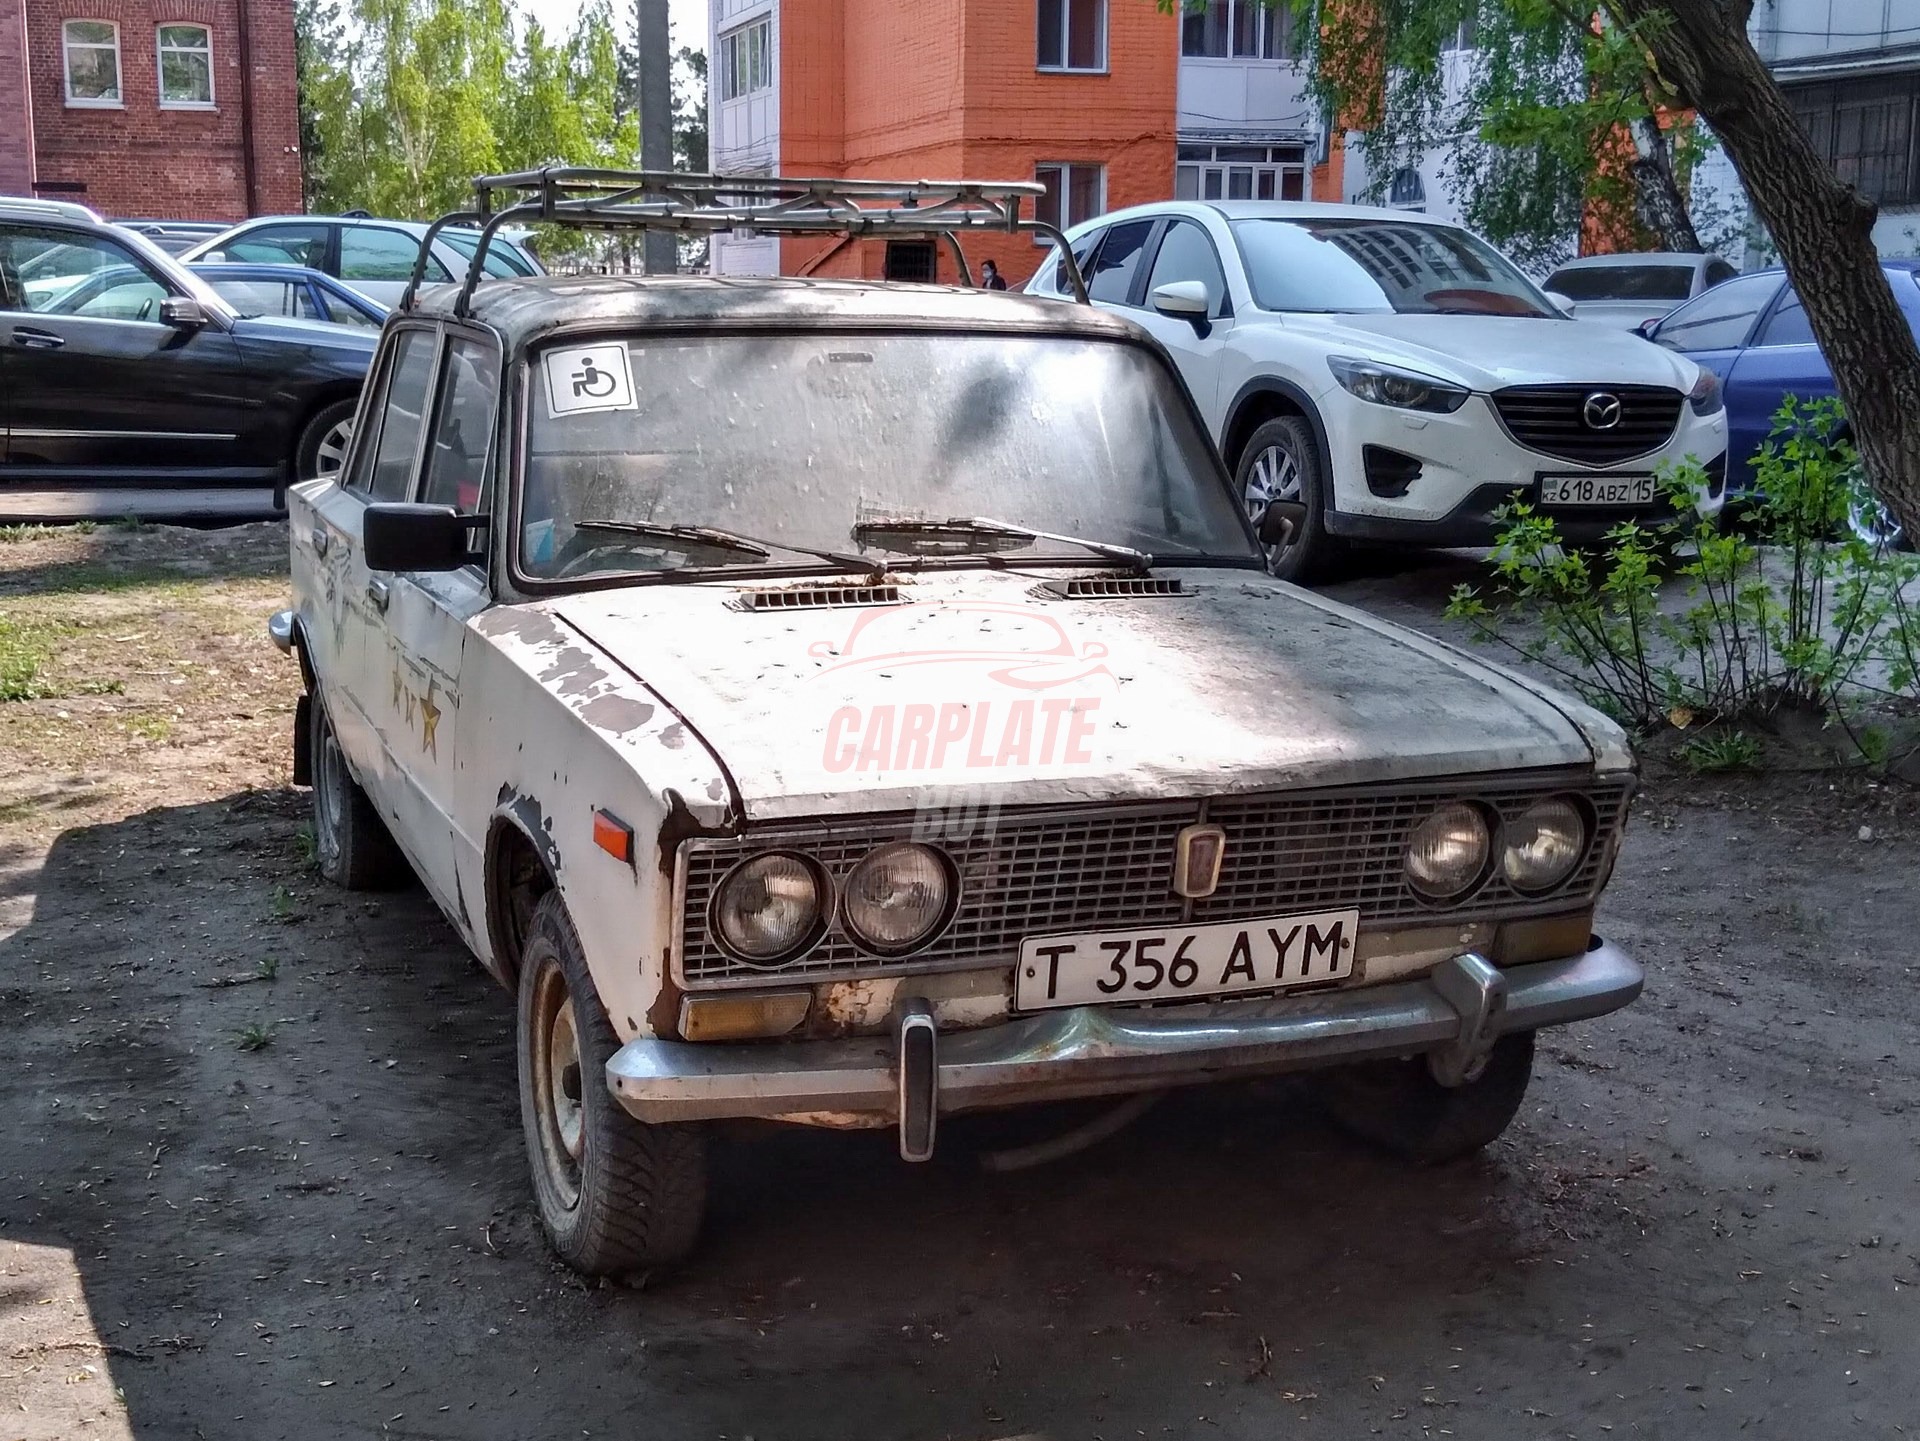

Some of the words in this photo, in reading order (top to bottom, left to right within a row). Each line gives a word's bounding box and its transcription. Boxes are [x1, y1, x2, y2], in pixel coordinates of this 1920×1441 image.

[1543, 492, 1556, 501] KZ
[1560, 481, 1593, 501] 618
[1596, 485, 1628, 501] ABZ
[1633, 480, 1651, 500] 15
[1036, 945, 1076, 999] T
[1096, 935, 1199, 994] 356
[1219, 920, 1343, 985] AYM
